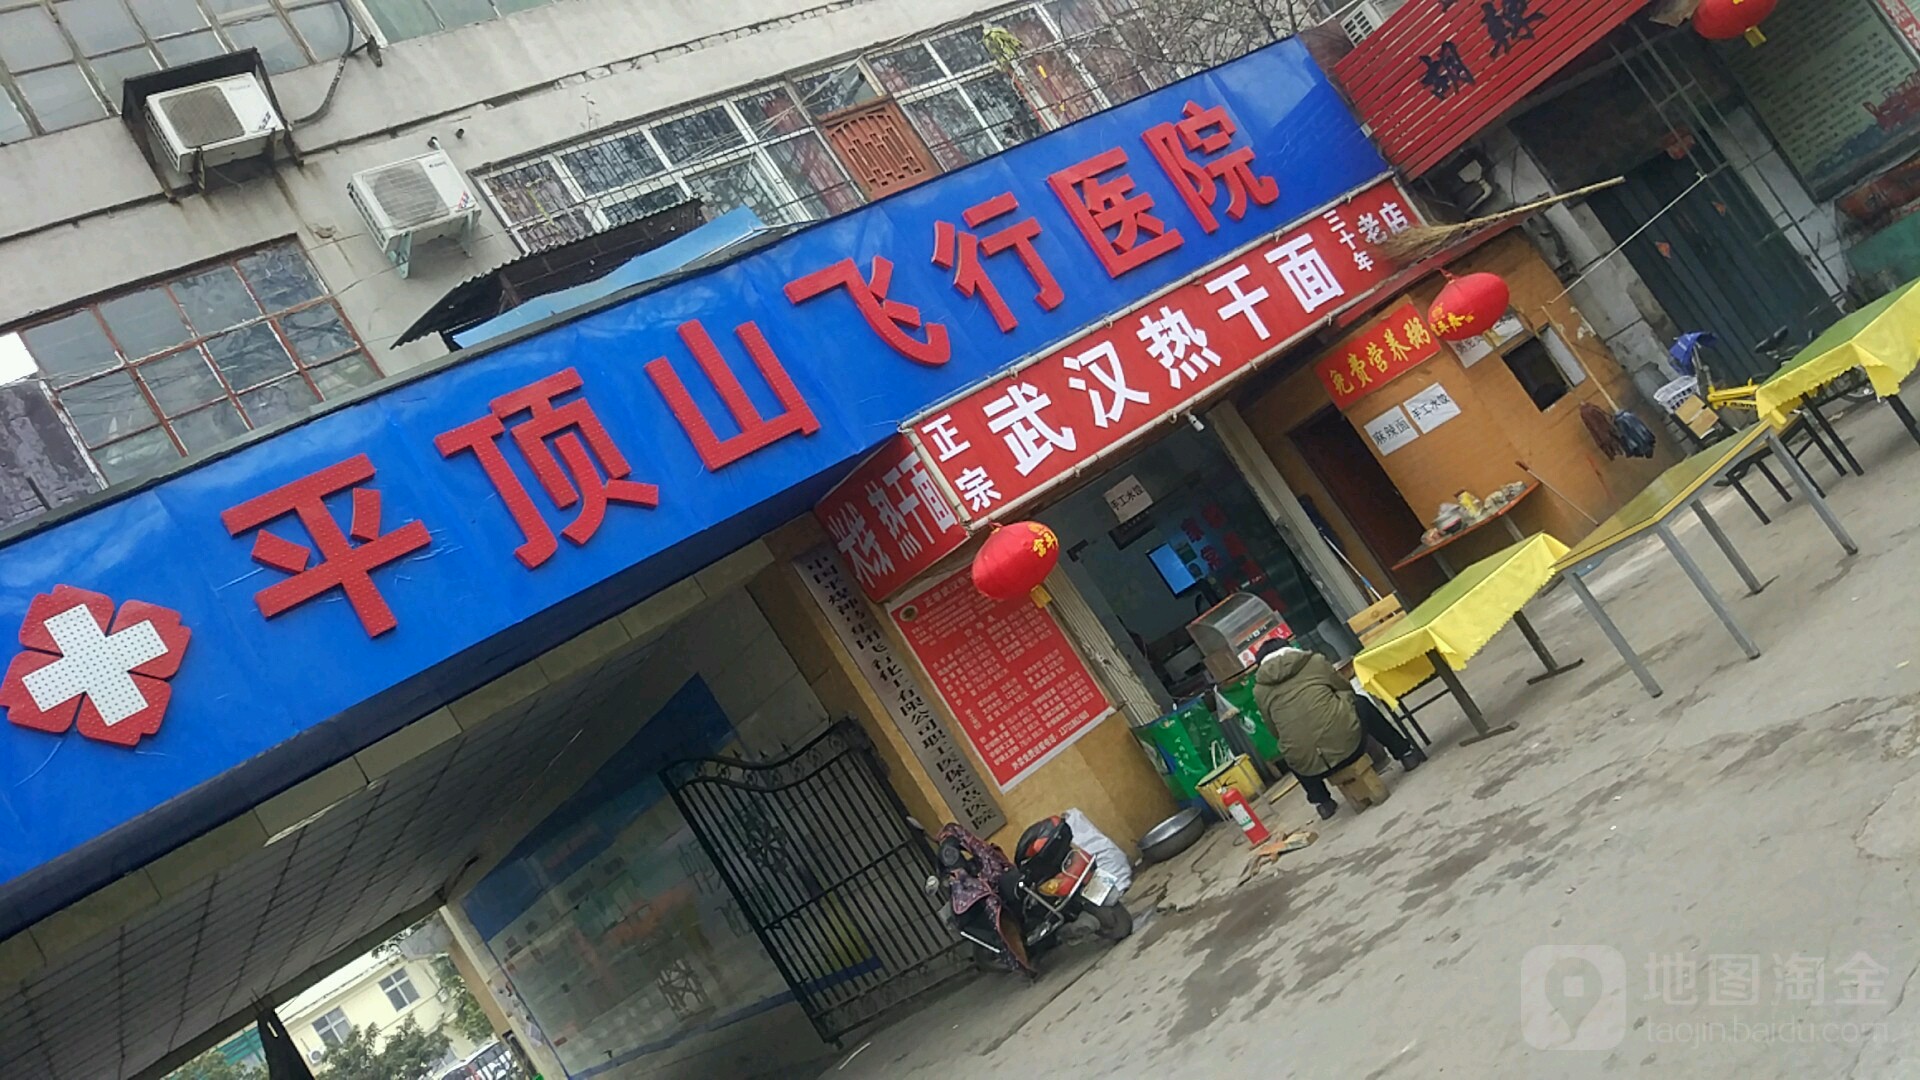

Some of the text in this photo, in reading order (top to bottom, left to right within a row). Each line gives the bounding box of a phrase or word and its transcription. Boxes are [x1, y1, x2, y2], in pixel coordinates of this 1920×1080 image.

[1323, 209, 1374, 272] 三十年
[1357, 201, 1409, 245] 老店
[222, 101, 1279, 637] 平顶山飞行医院
[982, 224, 1345, 477] 武汉热干面
[1328, 317, 1436, 396] 免费营养粥
[919, 408, 1002, 512] 正宗
